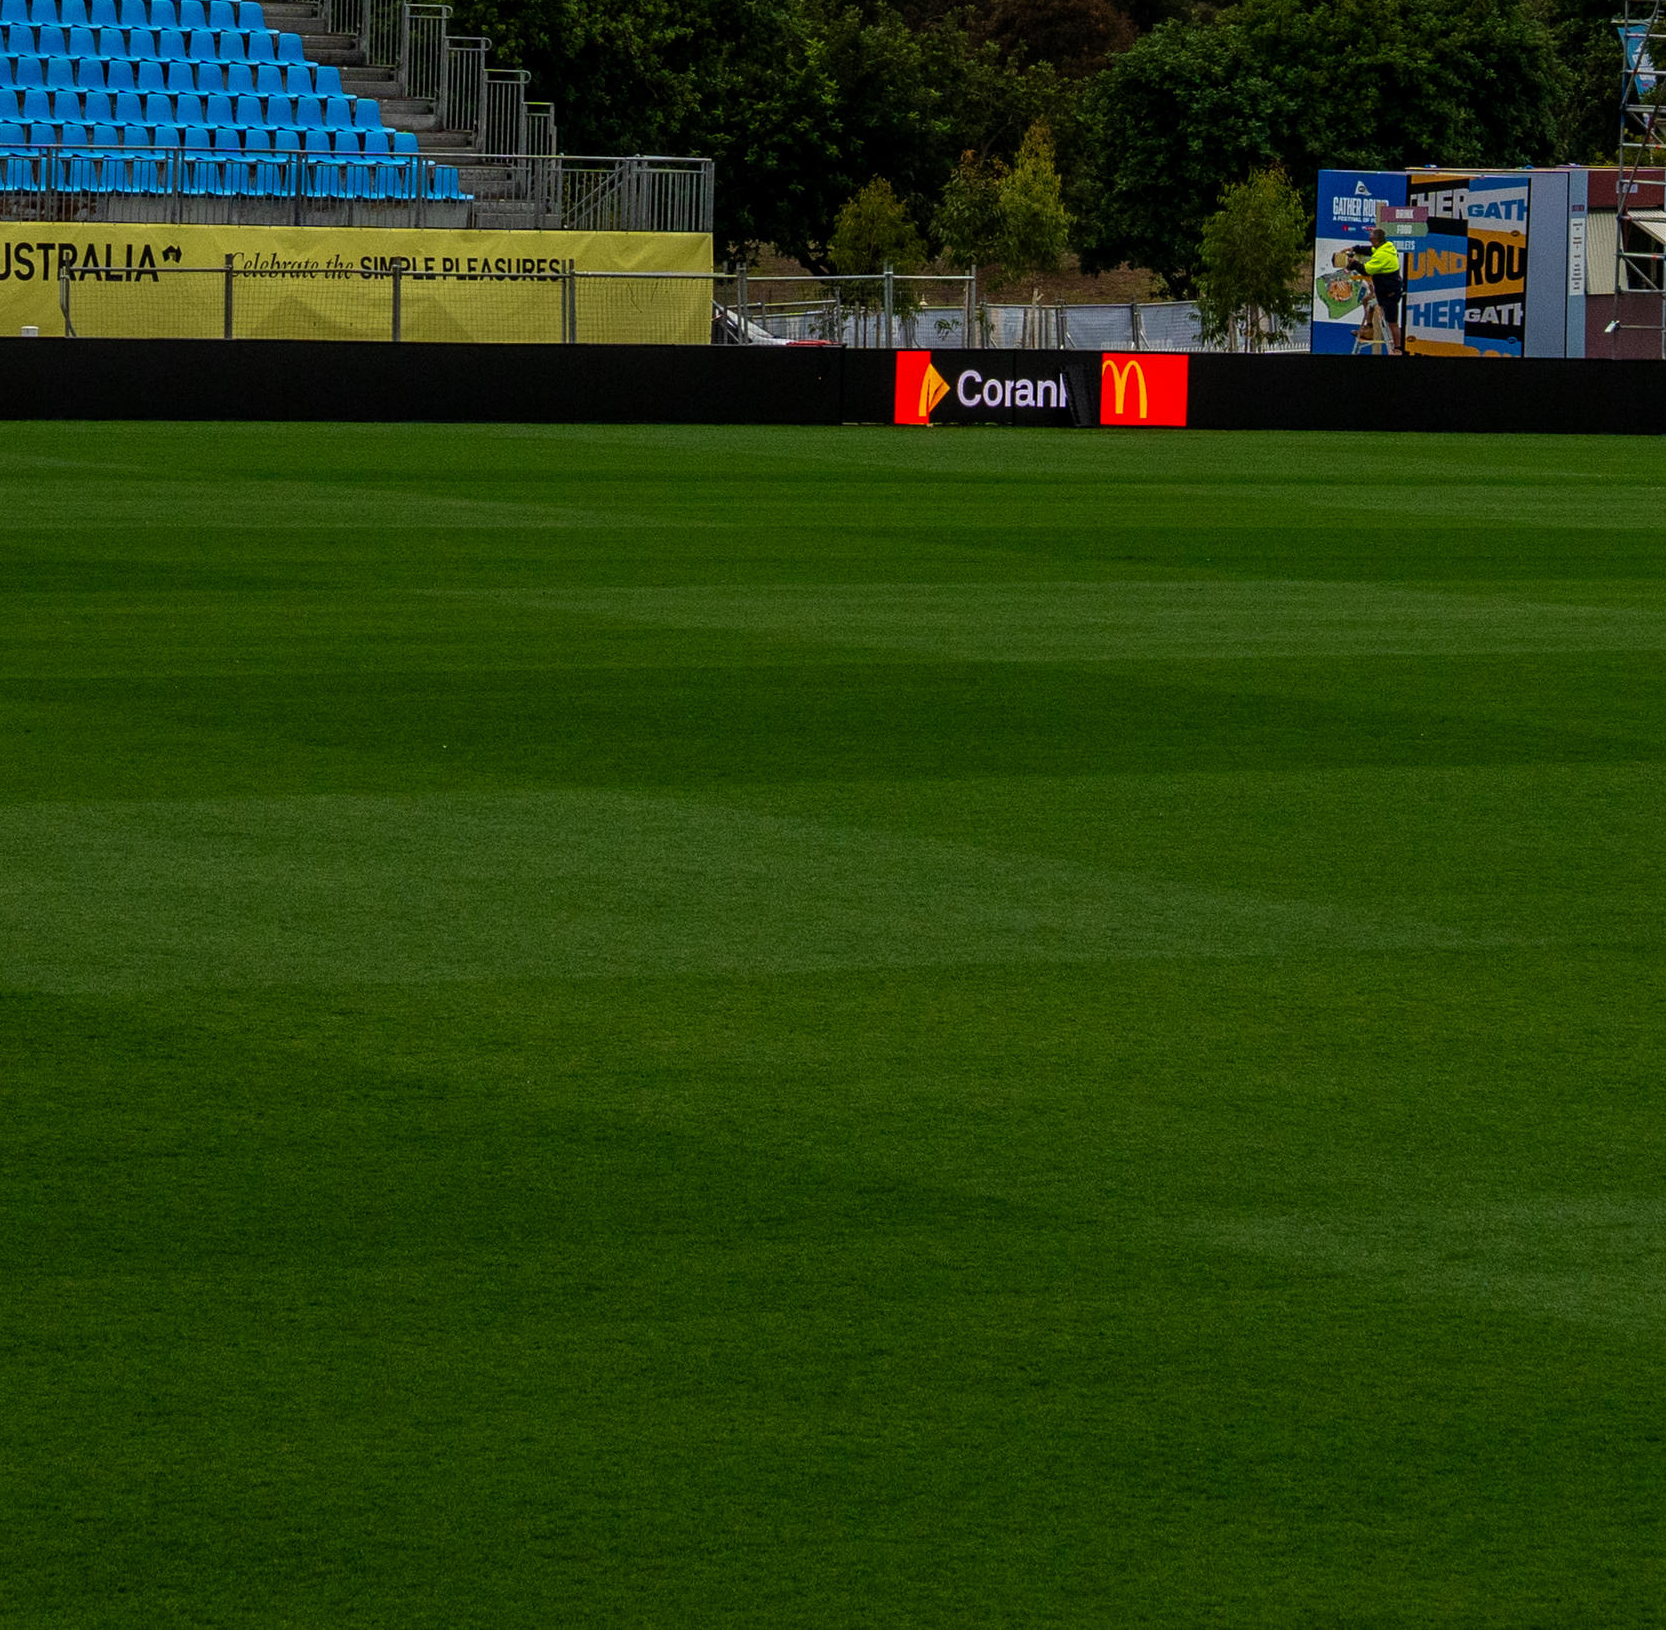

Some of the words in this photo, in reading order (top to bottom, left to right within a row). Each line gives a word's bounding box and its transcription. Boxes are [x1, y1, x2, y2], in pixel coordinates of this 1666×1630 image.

[1333, 196, 1362, 216] GATHER
[324, 254, 354, 280] the
[360, 256, 436, 280] SIMPLE
[442, 257, 562, 281] PLEASURES
